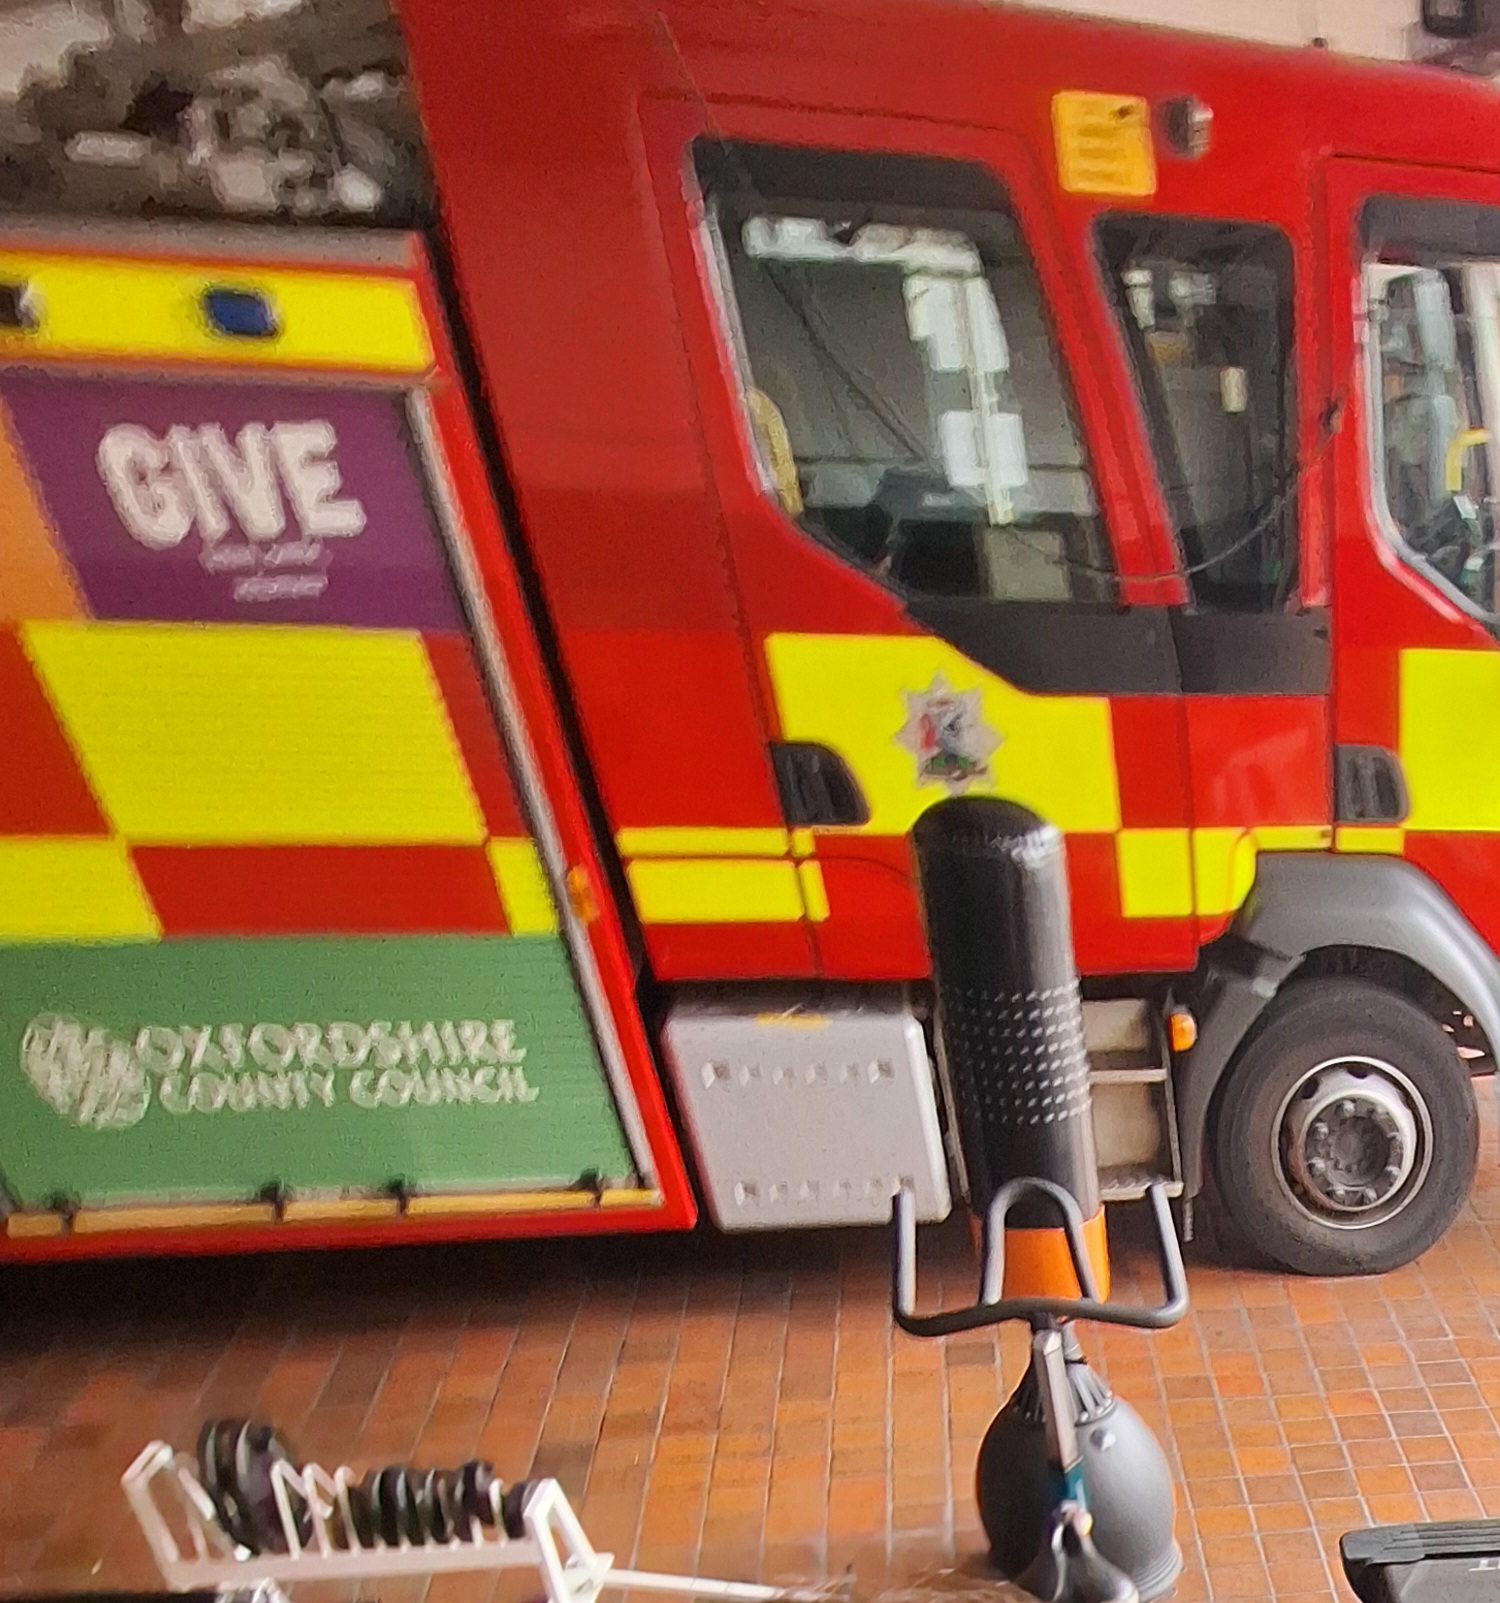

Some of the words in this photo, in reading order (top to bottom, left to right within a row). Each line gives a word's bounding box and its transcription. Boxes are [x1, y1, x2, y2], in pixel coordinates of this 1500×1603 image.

[98, 419, 367, 549] GIVE
[159, 1069, 335, 1115] COUNTY
[349, 1065, 540, 1109] COUNCIL
